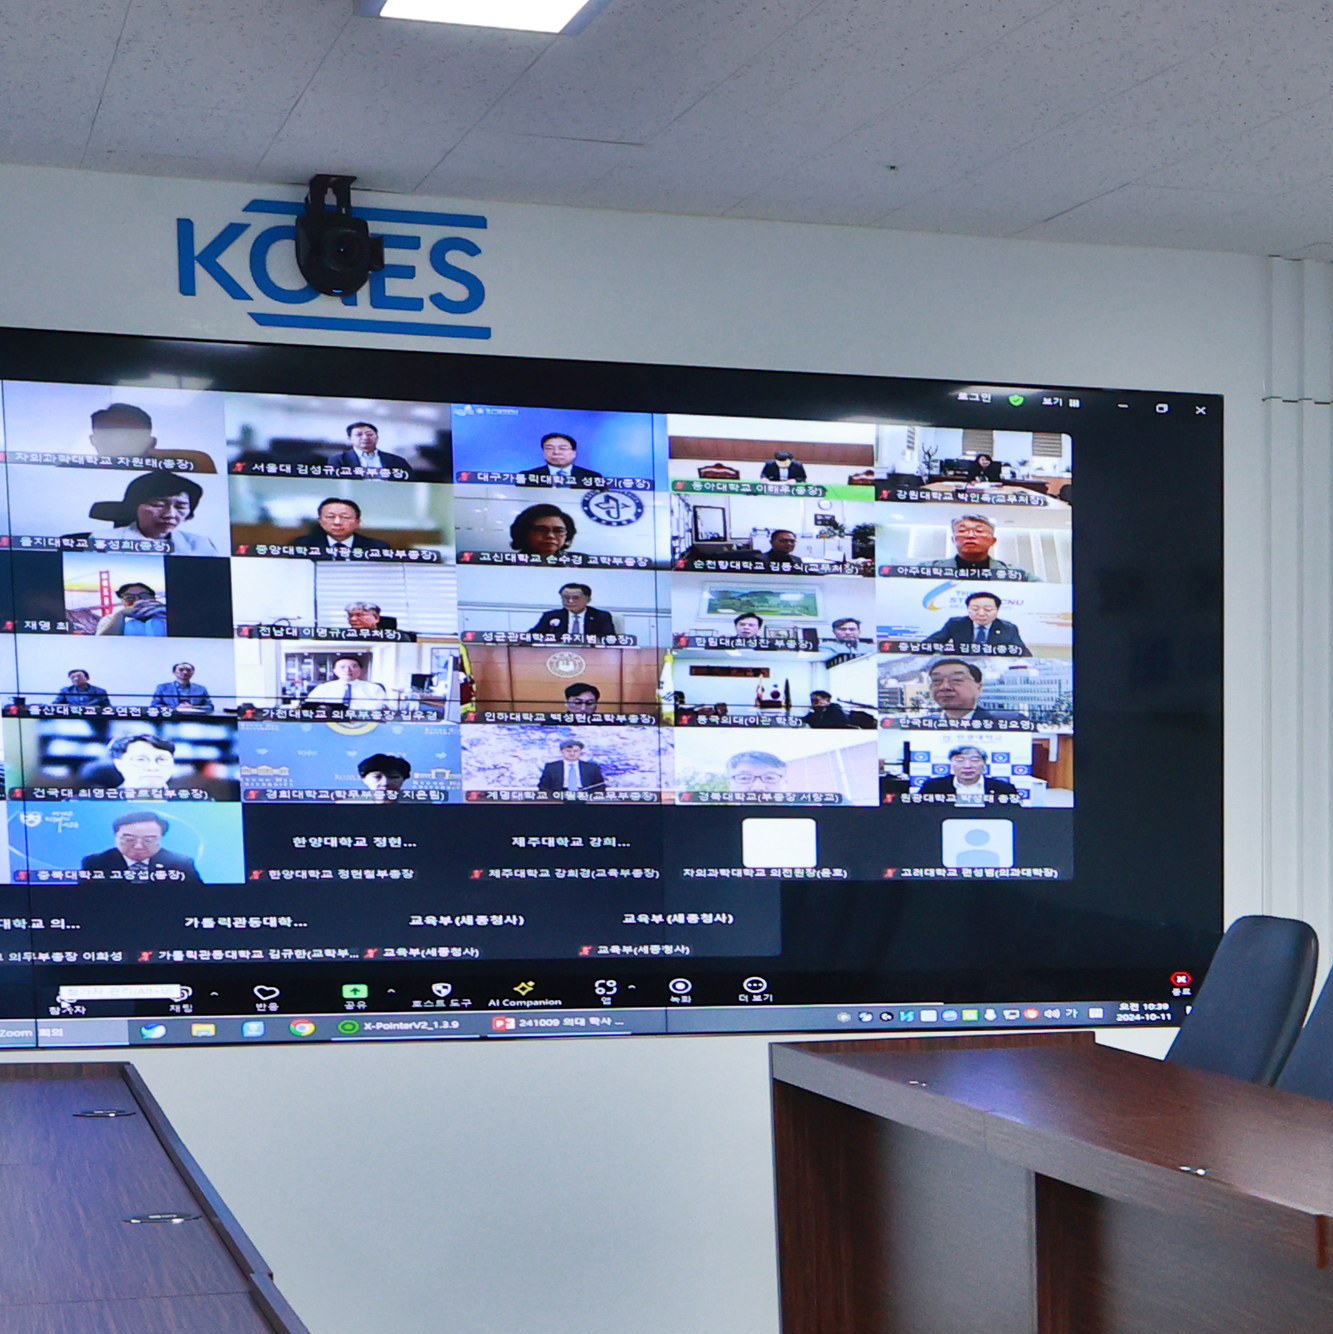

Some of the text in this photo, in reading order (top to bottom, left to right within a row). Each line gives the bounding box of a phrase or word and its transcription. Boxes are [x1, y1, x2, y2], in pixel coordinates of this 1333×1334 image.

[177, 218, 486, 315] KOES
[957, 393, 992, 404] 로그인
[1042, 396, 1063, 408] 보기
[252, 463, 292, 475] 서울대
[477, 473, 577, 486] 대구가톨릭대학교
[692, 482, 752, 493] 동아대학교
[897, 489, 953, 502] 강원대학교
[256, 545, 322, 557] 중앙대학교
[479, 552, 543, 564] 고신대학교
[588, 555, 649, 567] 교학부총장
[694, 560, 766, 571] 순천향대학교
[258, 627, 298, 638] 전남대
[482, 632, 557, 643] 성균관대학교
[601, 634, 634, 646] (총장)
[898, 642, 956, 653] 충남대학교
[28, 706, 98, 717] 울산대학교
[146, 707, 174, 718] 총장
[262, 708, 327, 719] 가천대학교
[484, 712, 546, 722] 인하대학교
[776, 716, 803, 728] 학장)
[33, 787, 73, 799] 건국대
[486, 791, 549, 801] 계명대학교
[900, 794, 957, 804] 원광대학교
[293, 836, 368, 848] 한양대학교
[512, 836, 584, 848] 제주대학교
[37, 870, 106, 881] 충북대학교
[268, 869, 333, 880] 한양대학교
[488, 869, 551, 879] 제주대학교
[901, 868, 958, 878] 고려대학교
[158, 949, 265, 961] 가톨릭관동대학교
[450, 998, 472, 1008] 도구
[738, 993, 774, 1003] 더 보기
[169, 1003, 194, 1014] 채팅
[255, 1001, 280, 1012] 반응
[344, 1000, 367, 1011] 공유
[488, 999, 563, 1009] AI Companion
[1118, 1003, 1140, 1012] 오전
[519, 1017, 560, 1028] 241009
[563, 1017, 585, 1027] 의대
[1116, 1013, 1172, 1023] 2024-10-11
[0, 1028, 33, 1037] Zoom
